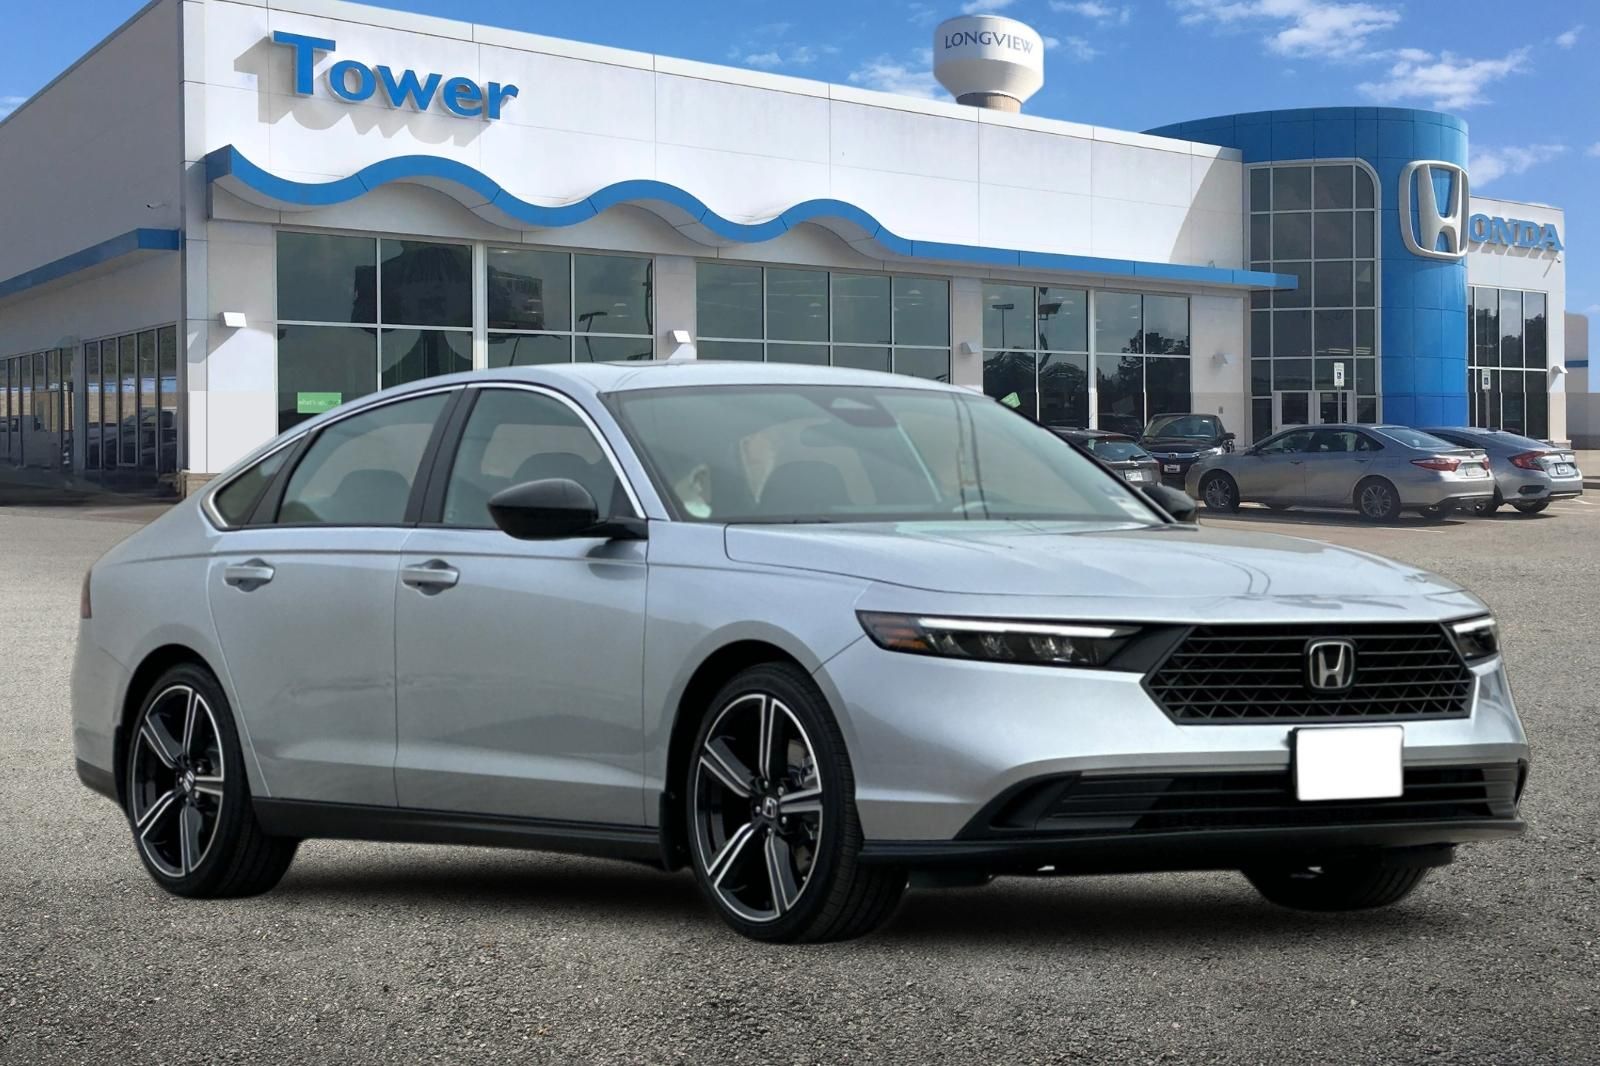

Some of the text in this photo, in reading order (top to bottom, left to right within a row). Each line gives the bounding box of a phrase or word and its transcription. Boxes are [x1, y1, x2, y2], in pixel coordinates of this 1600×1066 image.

[945, 31, 1033, 54] LONGVIEW
[272, 30, 520, 121] Tower
[1469, 213, 1564, 251] ONDA
